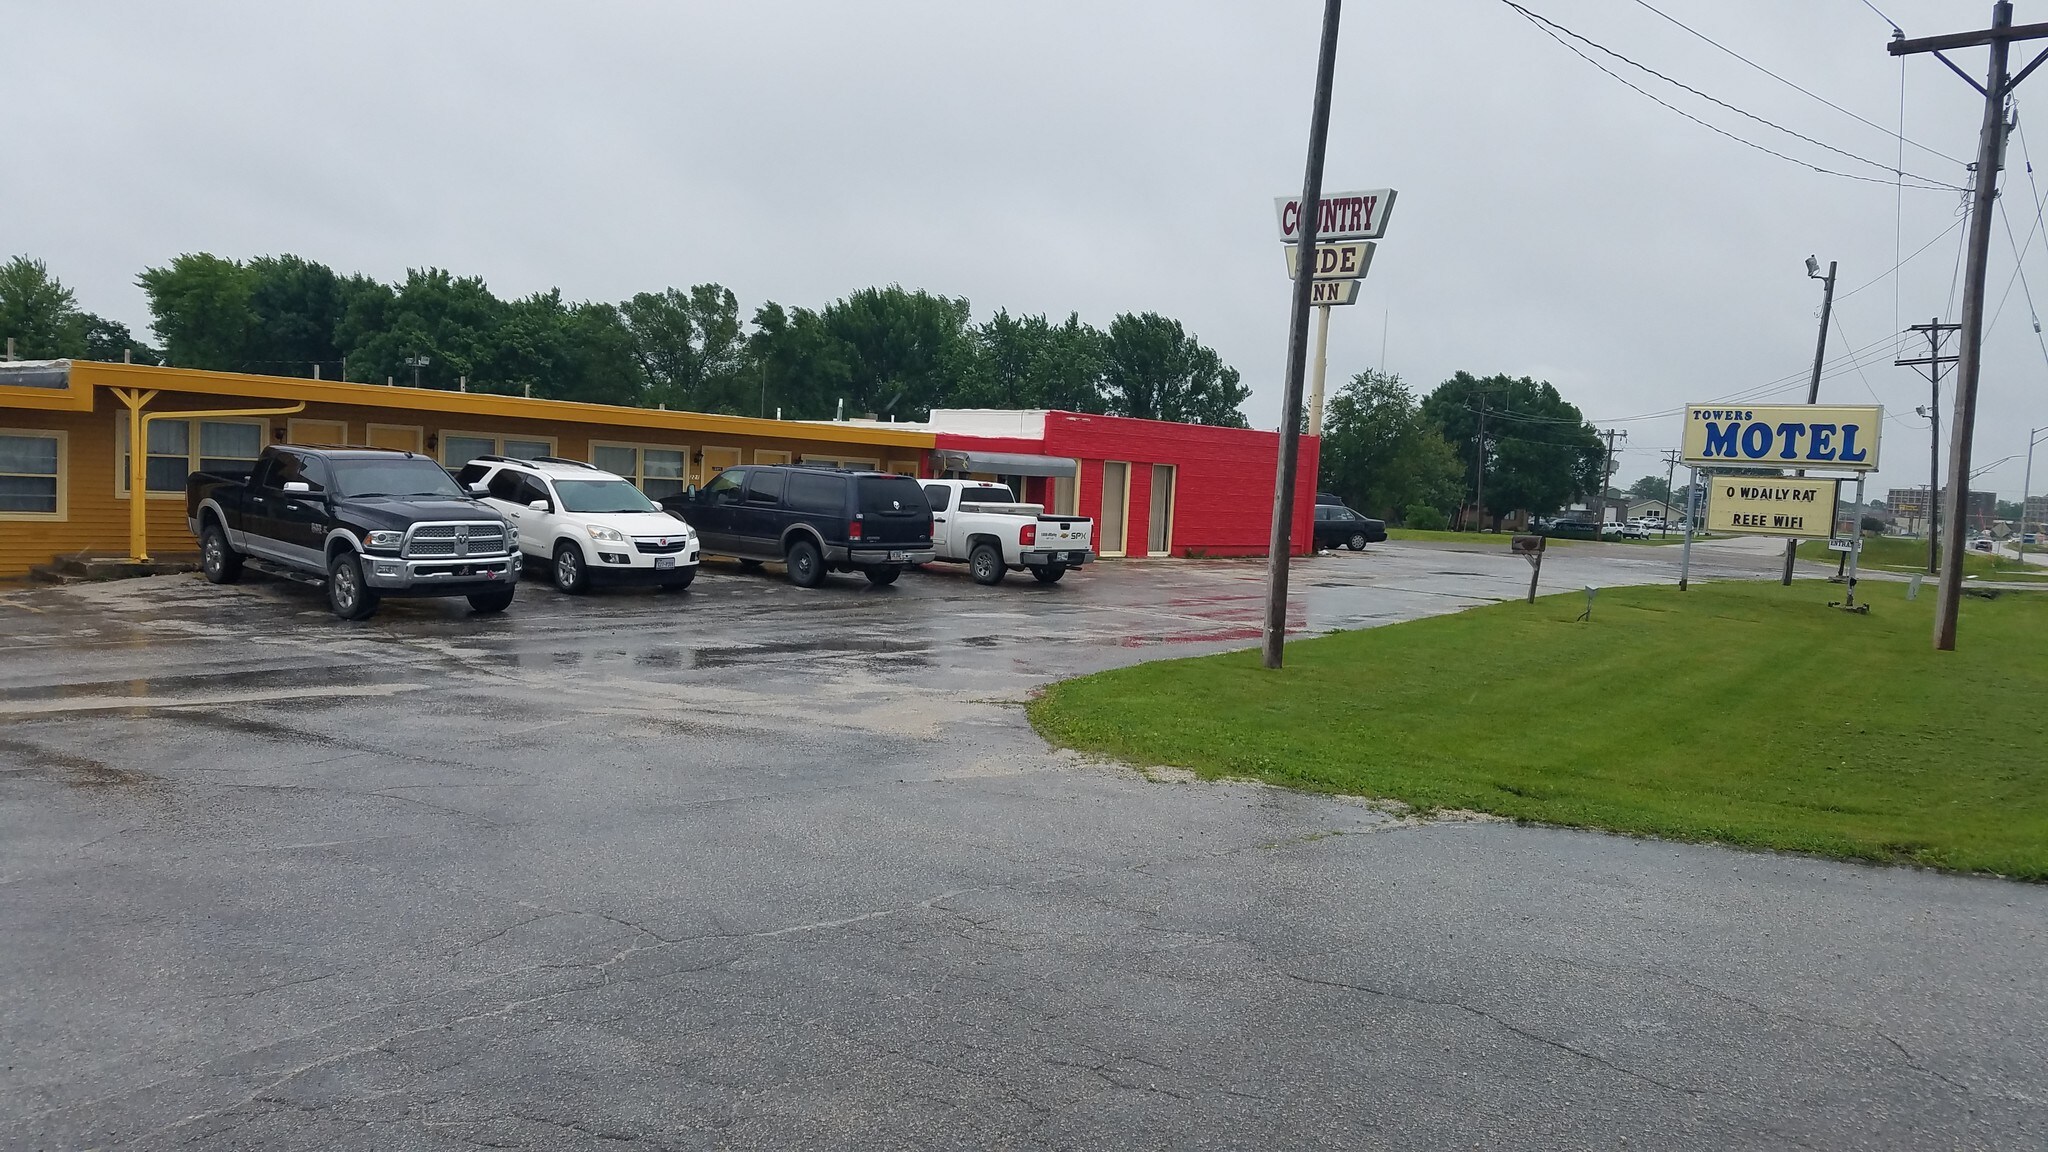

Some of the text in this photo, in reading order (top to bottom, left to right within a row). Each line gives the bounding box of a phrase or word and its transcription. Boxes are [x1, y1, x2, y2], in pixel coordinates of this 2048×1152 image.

[1312, 247, 1357, 273] IDE
[1313, 283, 1340, 301] NN
[1693, 410, 1753, 421] TOWERS
[1702, 422, 1867, 462] MOTEL
[1733, 513, 1803, 528] REEE WIFI
